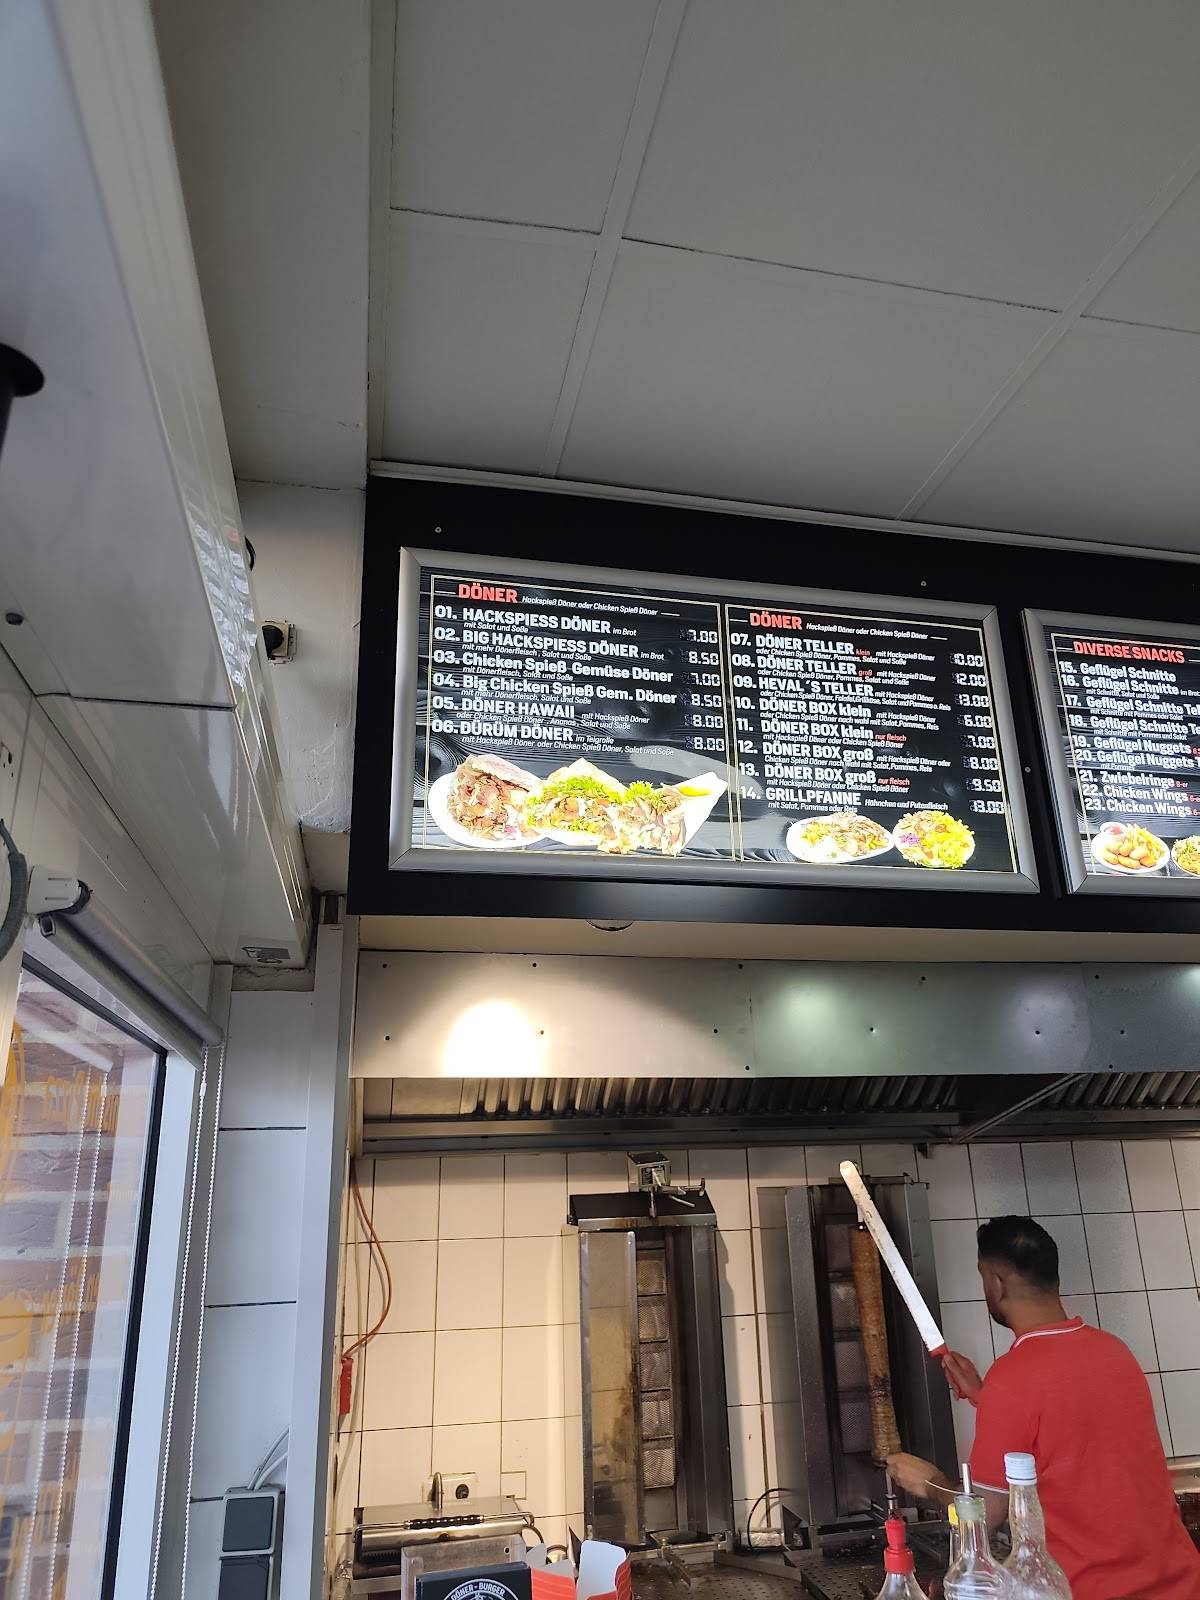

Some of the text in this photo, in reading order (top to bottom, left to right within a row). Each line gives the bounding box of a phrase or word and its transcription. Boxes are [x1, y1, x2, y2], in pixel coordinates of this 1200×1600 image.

[458, 583, 518, 603] DÖNER
[522, 596, 556, 606] Hackspieß
[558, 600, 577, 608] Döner
[594, 603, 619, 612] Chicken
[620, 606, 638, 614] Spieß
[434, 605, 457, 619] 01.
[463, 608, 558, 628] HACKSPIESS
[561, 615, 611, 634] DÖNER
[622, 628, 637, 636] Brot
[477, 622, 496, 630] Salat
[497, 624, 511, 632] und
[750, 611, 802, 630] DÖNER
[806, 623, 837, 632] Hackspieß
[838, 626, 855, 634] Döner
[870, 629, 893, 637] Chicken
[894, 631, 910, 639] Spieß
[911, 632, 928, 640] Döner
[434, 627, 664, 660] 02. BIG HACKSPIESS DÖNER im Brot
[731, 633, 751, 646] 07.
[755, 633, 802, 651] DÖNER
[803, 639, 854, 655] TELLER
[1073, 641, 1185, 664] DIVERSE SNACKS
[433, 650, 673, 683] 03. Chicken Spieß Gemüse Döner
[688, 651, 719, 665] 8.50
[732, 654, 755, 667] 08.
[757, 655, 804, 671] DÖNER
[805, 660, 857, 676] TELLER
[542, 672, 555, 680] und
[690, 672, 720, 687] 7.00
[956, 673, 986, 687] 12.00
[1059, 661, 1177, 682] 15. Geflügel Schnitte
[433, 673, 677, 704] 04. Big Chicken Spieß Gem. Döner
[733, 675, 757, 688] 09.
[759, 677, 804, 692] HEVAL
[822, 682, 874, 697] TELLER
[1061, 674, 1080, 687] 16.
[1083, 675, 1130, 692] Geflügel
[1131, 679, 1179, 695] Schnitte
[432, 696, 575, 718] 05. DÖNER HAWAII
[691, 693, 722, 708] 8.50
[735, 696, 872, 718] 10. DÖNER BOX klein
[959, 694, 990, 708] 13.00
[1065, 694, 1082, 706] 17.
[1086, 696, 1134, 713] Geflügel
[1135, 700, 1184, 715] Schnitte
[432, 720, 458, 734] 06.
[460, 720, 517, 738] DÜRÜM
[521, 725, 573, 741] DÖNER
[692, 714, 723, 728] 8.00
[737, 718, 753, 731] 11.
[761, 718, 809, 735] DÖNER
[811, 723, 840, 737] BOX
[841, 724, 874, 740] klein
[964, 714, 993, 728] 6.00
[1069, 714, 1087, 727] 18.
[1090, 715, 1138, 732] Geflügel
[1139, 719, 1188, 734] Schnitte
[694, 737, 725, 751] 8.00
[738, 740, 874, 762] 12. DÖNER BOX groß
[968, 735, 995, 749] 7.00
[1072, 735, 1091, 748] 19.
[1093, 736, 1141, 753] Geflügel
[1144, 739, 1192, 755] Nuggets
[969, 756, 998, 771] 8.00
[1075, 749, 1097, 762] 20.
[1097, 750, 1144, 767] Geflügel
[1145, 753, 1195, 769] Nuggets
[739, 763, 759, 777] 13.
[764, 763, 812, 780] DÖNER
[815, 767, 843, 782] BOX
[845, 770, 876, 785] groß
[1079, 769, 1098, 783] 21.
[1100, 770, 1175, 789] Zwiebelringe
[741, 785, 760, 800] 14.
[766, 787, 861, 806] GRILLPFANNE
[865, 799, 896, 808] Hähnchen
[910, 801, 949, 811] Putenfleisch
[1082, 784, 1103, 797] 22.
[1104, 784, 1151, 799] Chicken
[1151, 788, 1189, 803] Wings
[801, 804, 828, 812] Pommes
[1084, 798, 1106, 811] 23.
[1106, 799, 1153, 814] Chicken
[1153, 802, 1192, 817] Wings
[478, 1582, 506, 1597] BURGER
